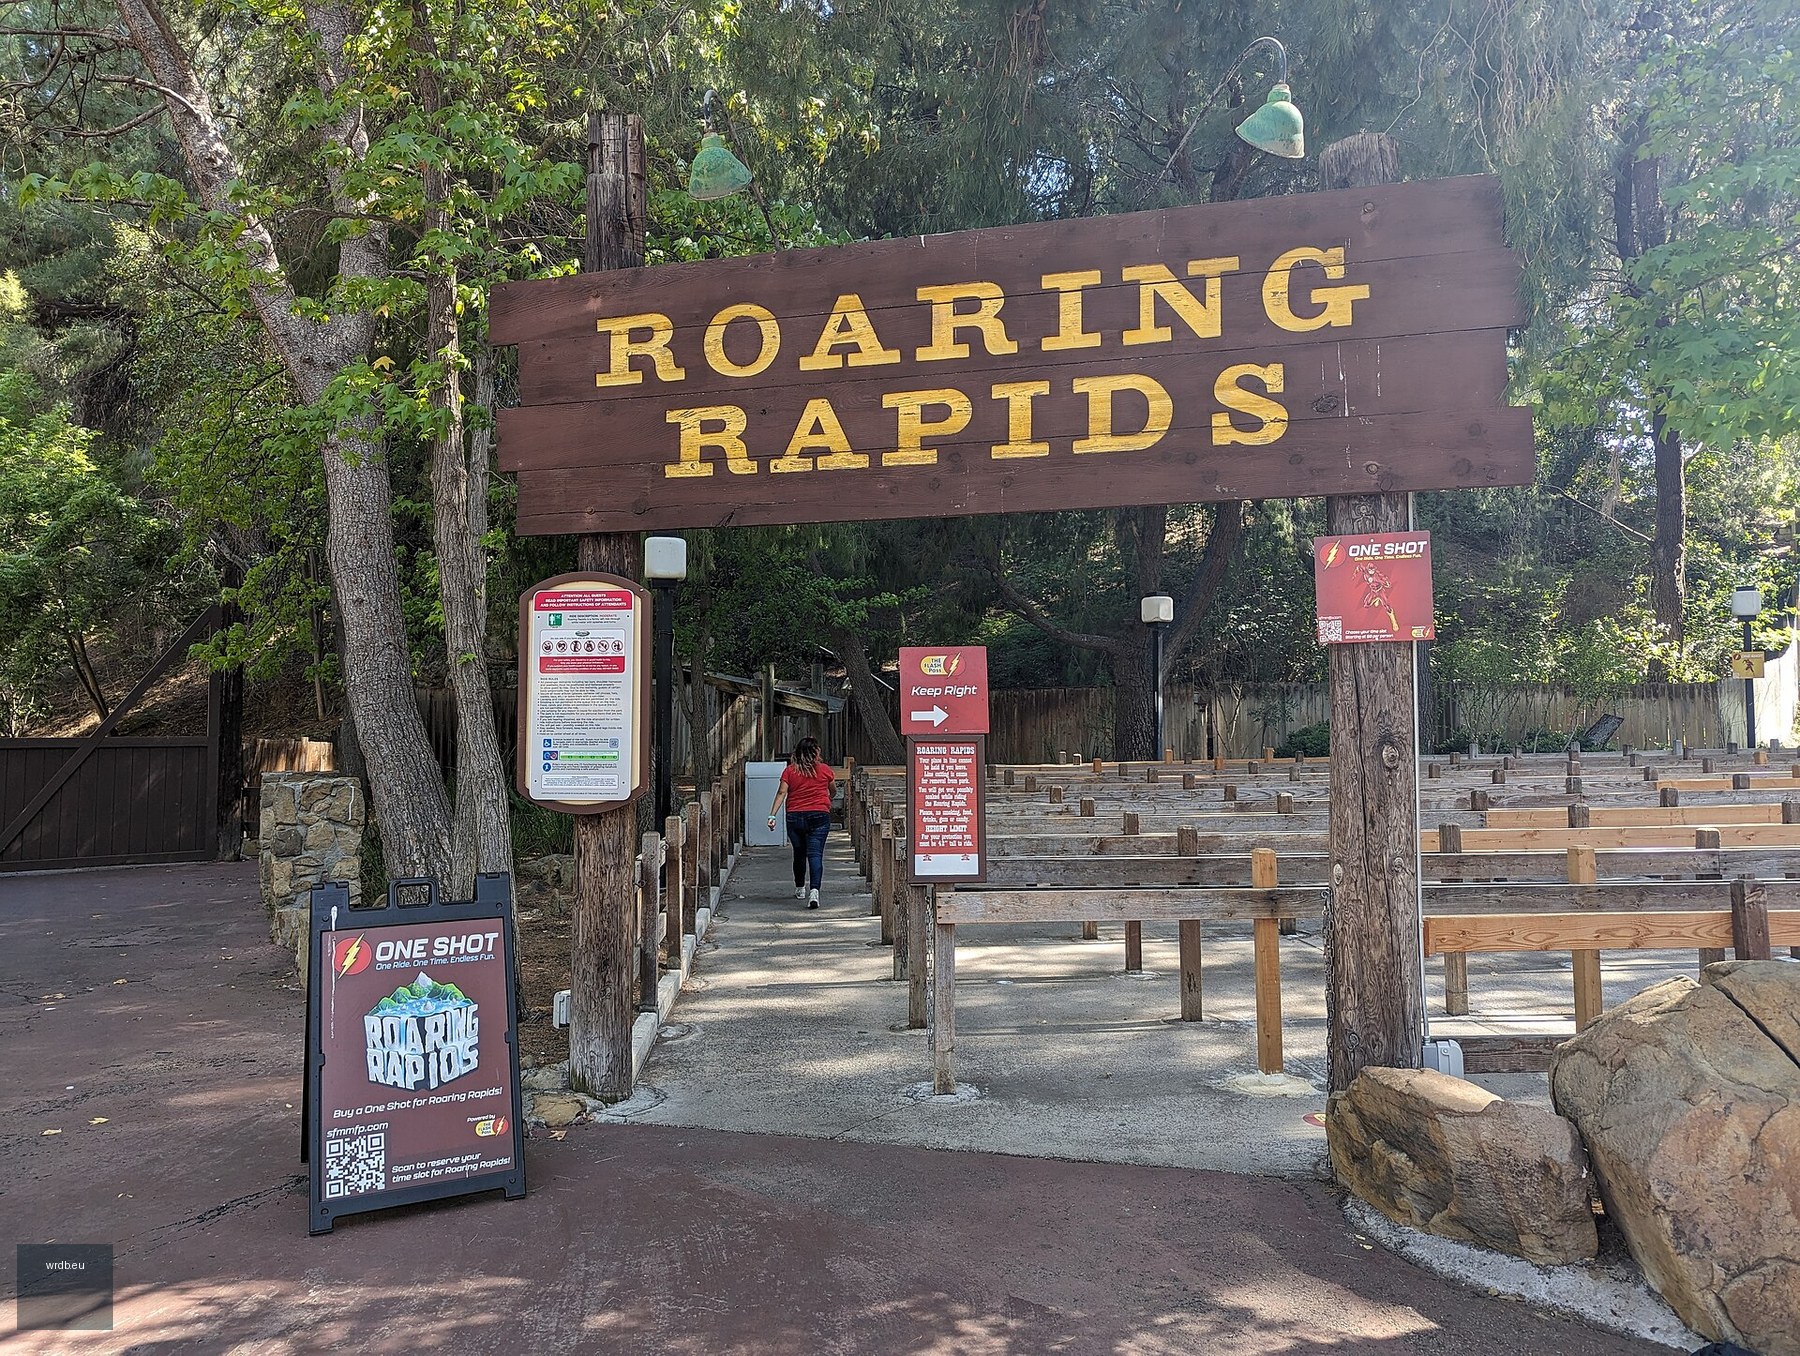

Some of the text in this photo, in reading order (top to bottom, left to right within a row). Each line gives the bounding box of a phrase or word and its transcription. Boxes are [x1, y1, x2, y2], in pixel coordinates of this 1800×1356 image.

[594, 246, 1371, 388] ROARING
[664, 362, 1289, 478] RAPIDS
[1348, 540, 1428, 556] ONE SHOT
[911, 685, 978, 697] Keep Right
[375, 932, 499, 961] ONE SHOT
[393, 960, 411, 969] Ride.
[450, 955, 478, 964] Endless
[364, 1004, 479, 1054] ROARING
[366, 1036, 479, 1090] RAPIDS
[333, 1109, 354, 1118] Buy
[365, 1104, 385, 1114] One
[387, 1101, 411, 1111] Shot
[412, 1099, 427, 1109] for
[428, 1093, 466, 1105] Roaring
[467, 1086, 503, 1100] Rapids!
[326, 1121, 389, 1138] sfmmfp.com
[391, 1164, 415, 1173] Scan
[427, 1157, 460, 1168] reserve
[460, 1153, 482, 1164] your
[392, 1157, 511, 1183] time slot for Roaring Rapids!
